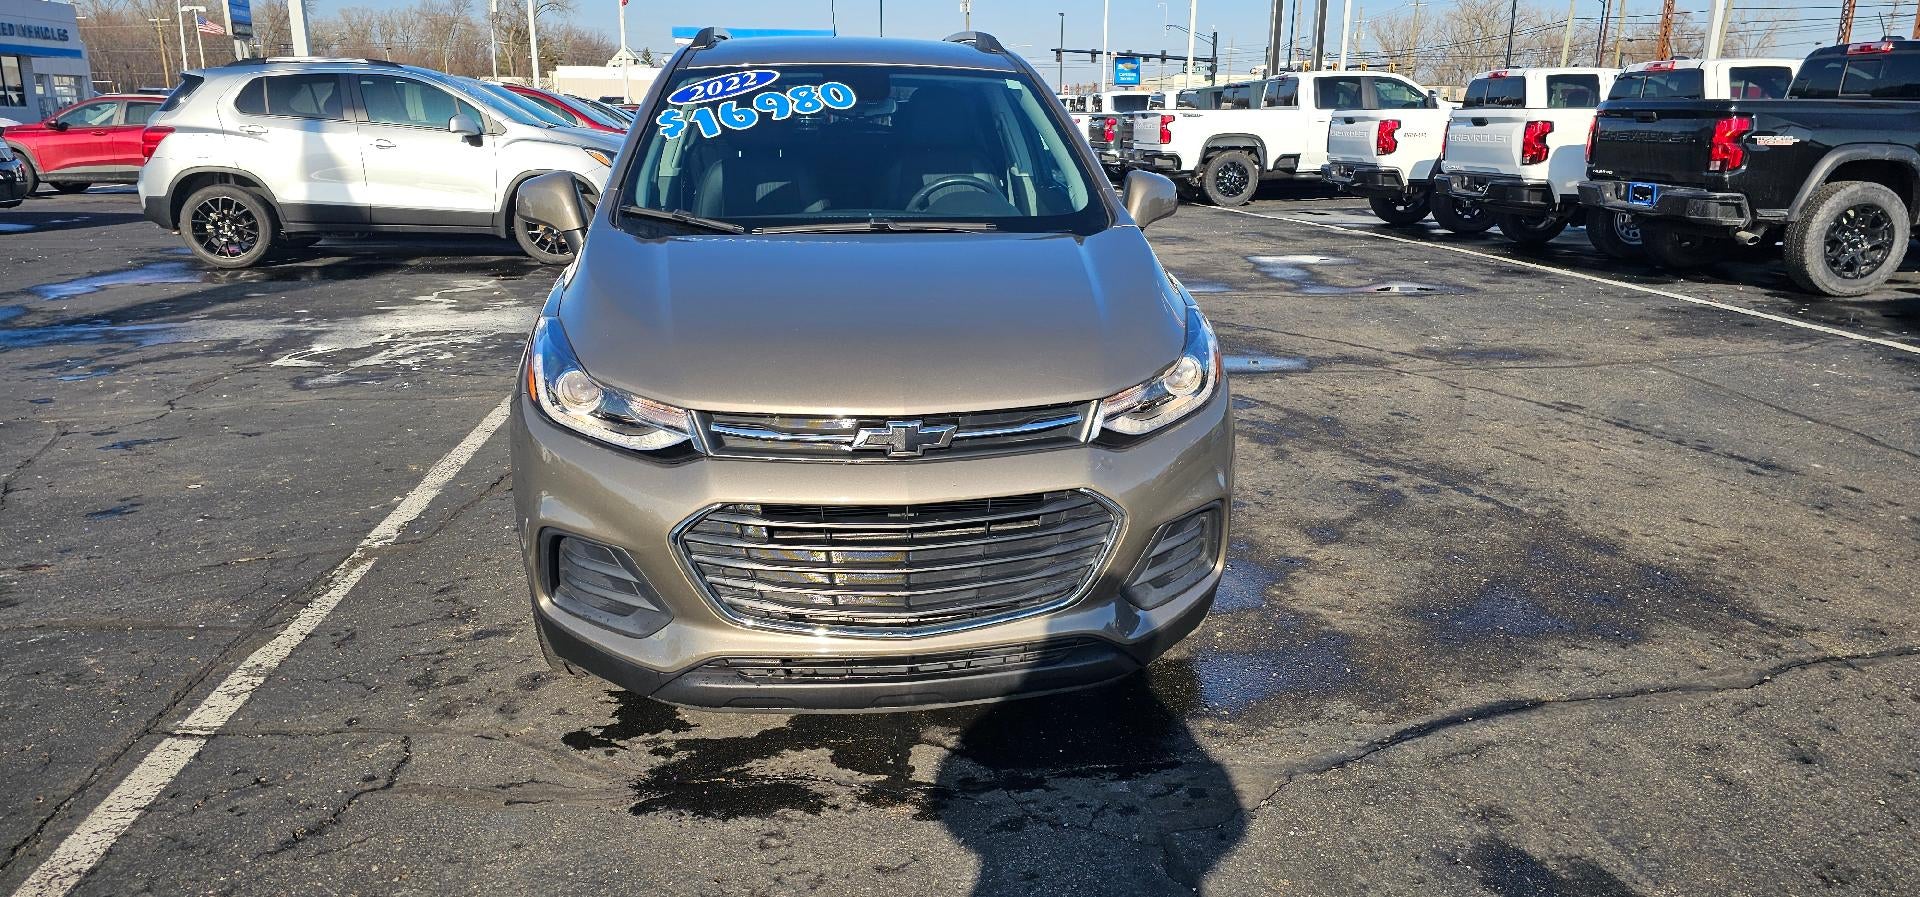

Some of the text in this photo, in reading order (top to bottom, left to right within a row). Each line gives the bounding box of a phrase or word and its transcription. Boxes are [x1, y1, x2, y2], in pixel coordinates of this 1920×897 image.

[20, 24, 69, 41] VEHICLES
[688, 72, 758, 102] 2022
[655, 81, 857, 140] $16980
[1449, 133, 1511, 143] CHEVROLET
